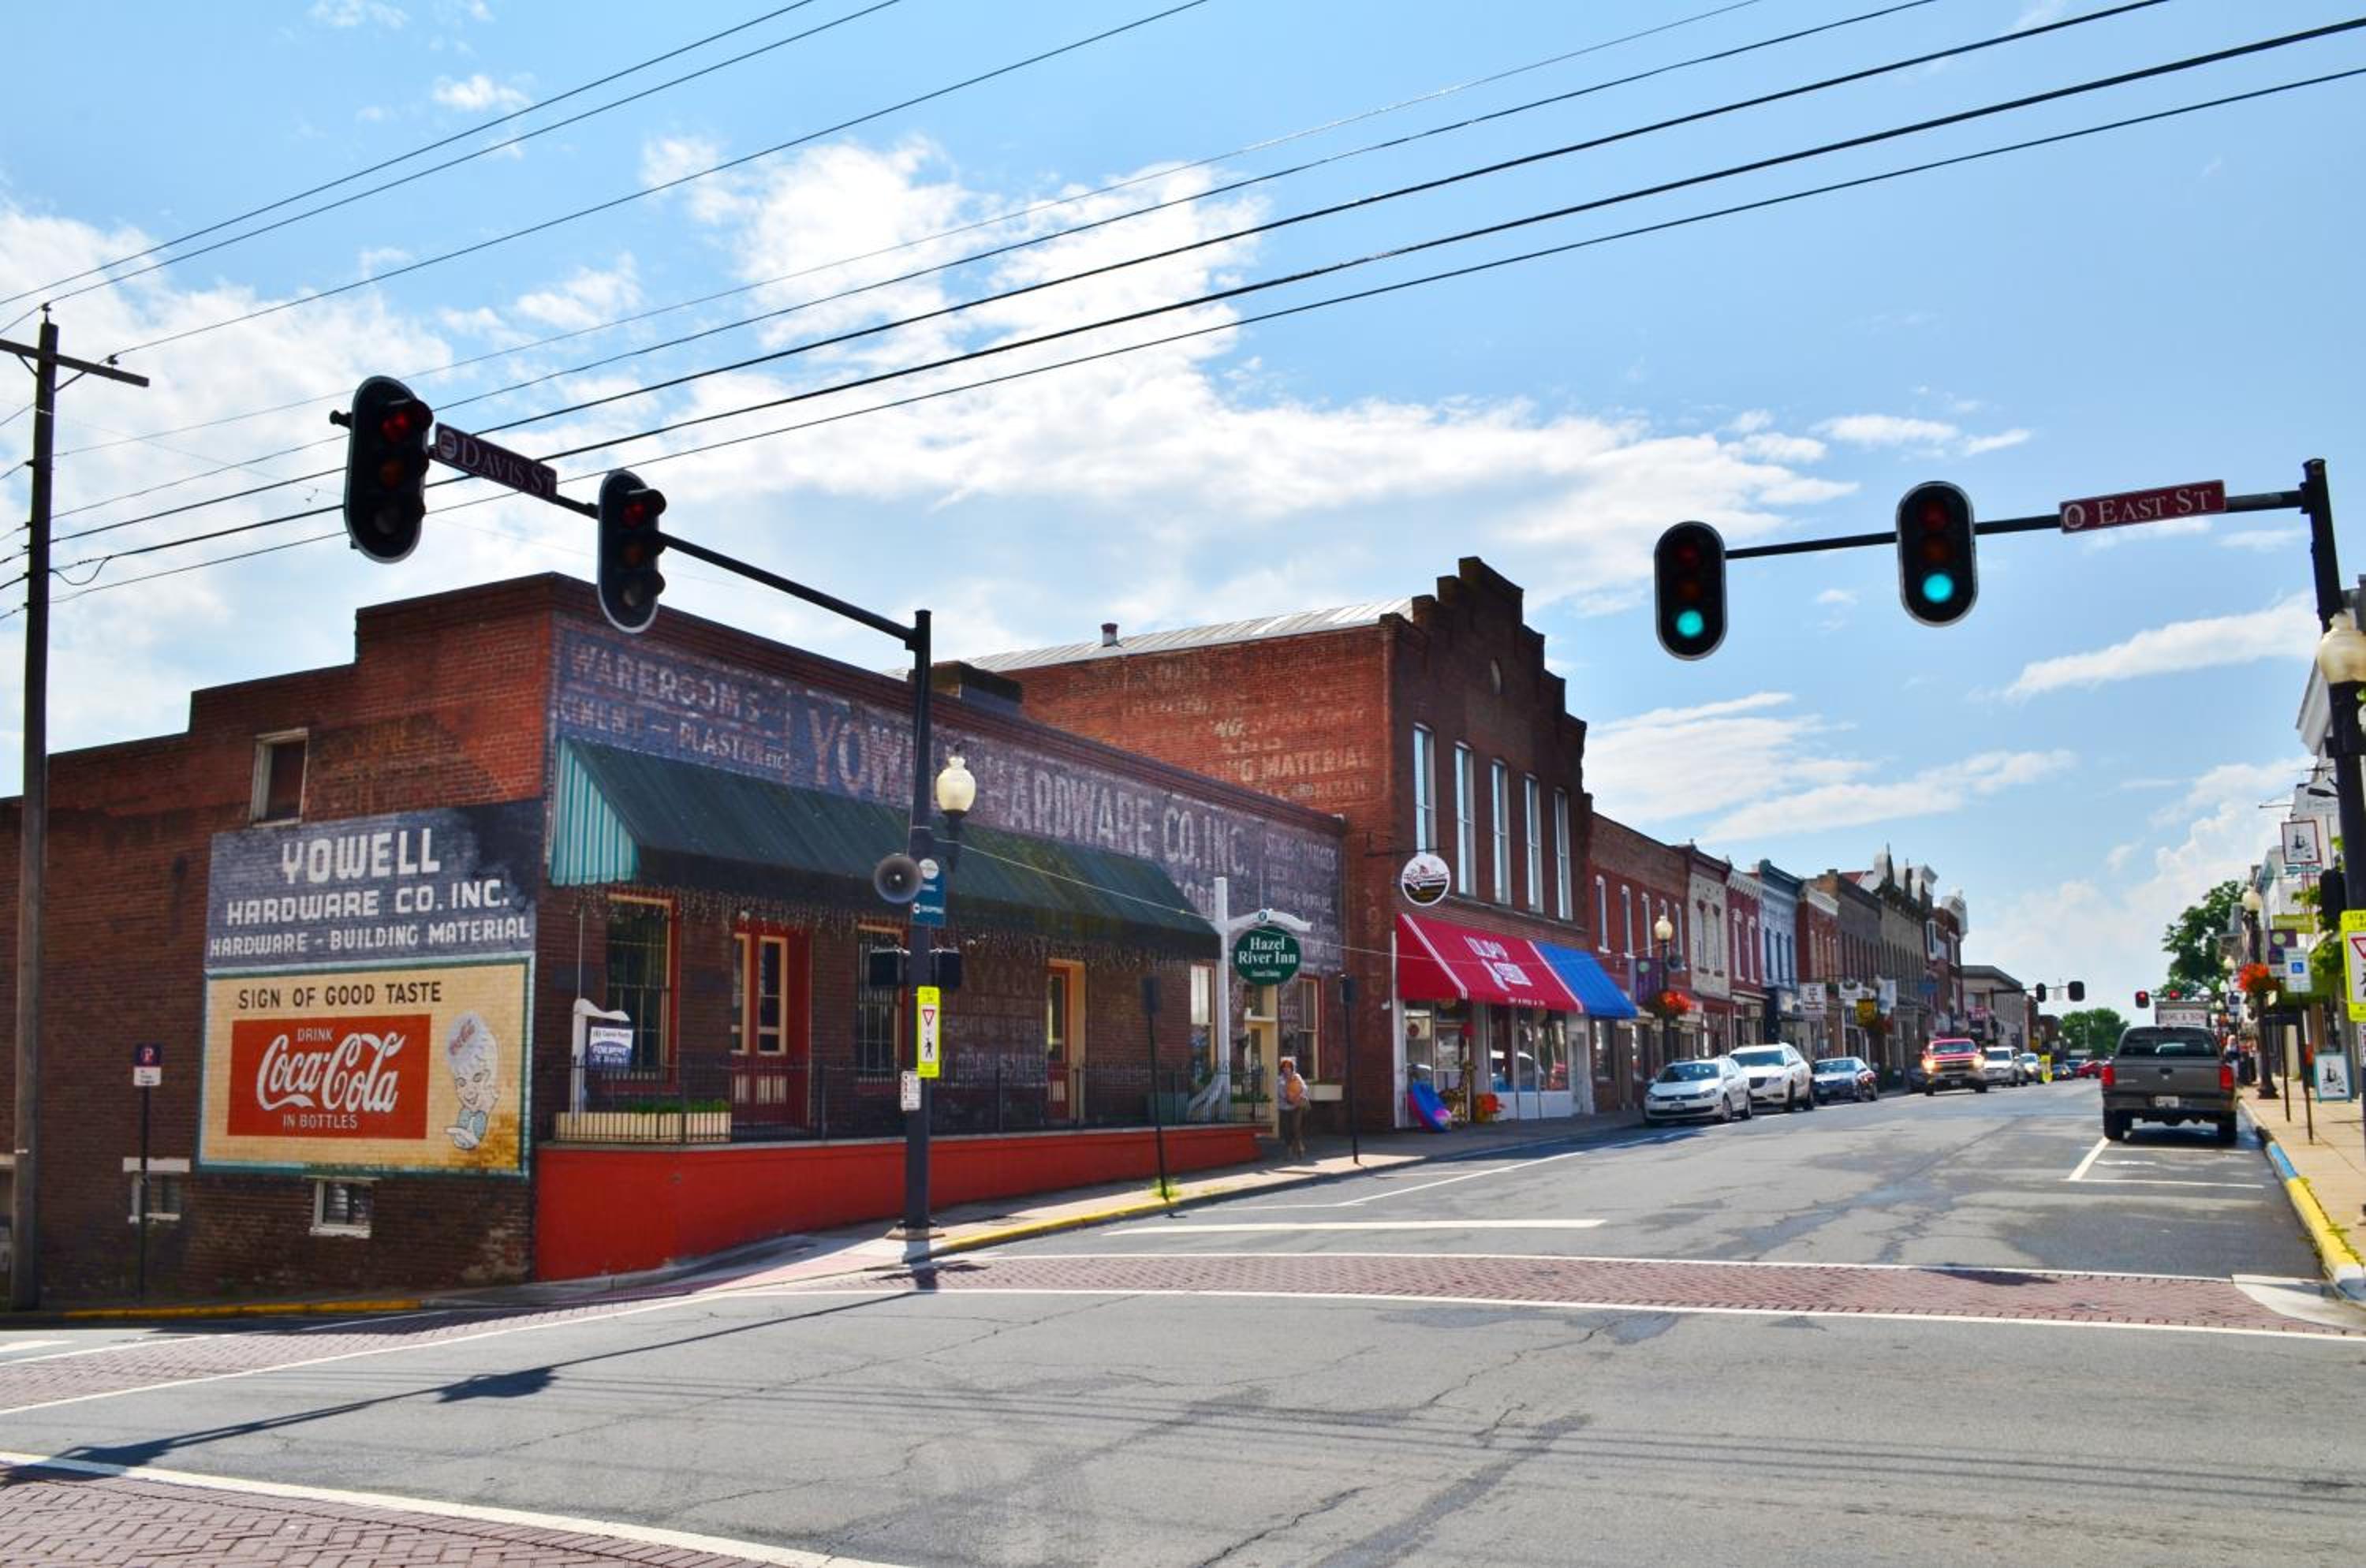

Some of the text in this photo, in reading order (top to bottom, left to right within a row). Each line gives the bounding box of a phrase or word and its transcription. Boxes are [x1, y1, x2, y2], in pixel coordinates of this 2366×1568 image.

[2097, 495, 2167, 525] EAST
[282, 828, 440, 884] YOWELL
[227, 879, 509, 926] HARDWARE CO. INC.
[210, 932, 308, 958] HARDWARE
[330, 925, 418, 950] BUILDING
[428, 917, 530, 944] MATERIAL
[1249, 936, 1285, 950] Hazel
[1238, 950, 1297, 965] River Inn
[238, 981, 442, 1010] SIGN OF GOOD TASTE
[297, 1027, 333, 1043] DRINK
[256, 1031, 405, 1114] Coca-Cola
[282, 1114, 357, 1129] IN BOTTLES
